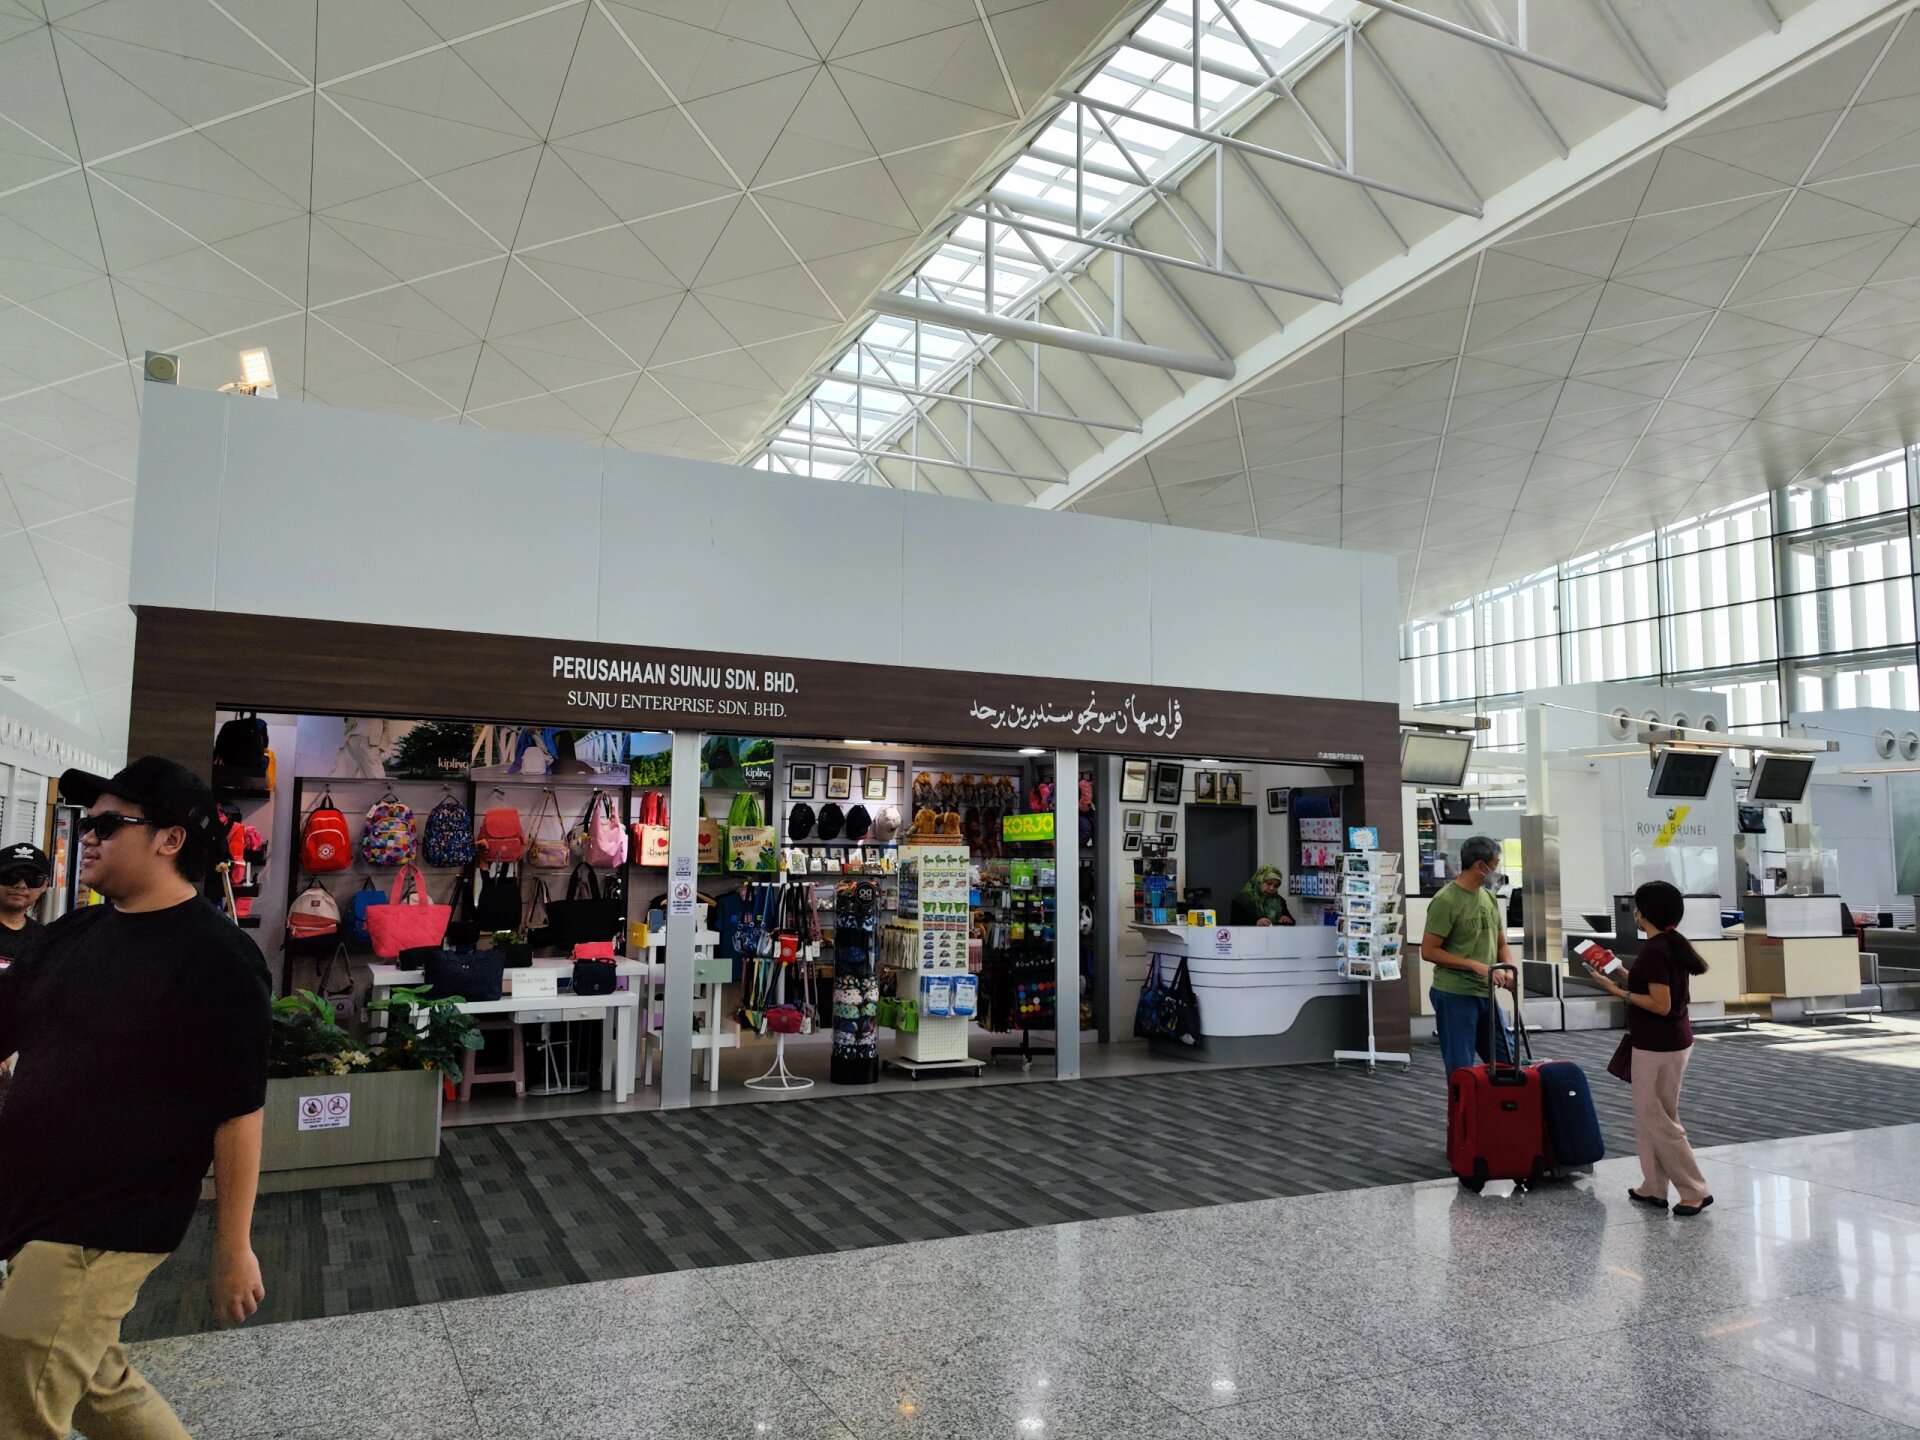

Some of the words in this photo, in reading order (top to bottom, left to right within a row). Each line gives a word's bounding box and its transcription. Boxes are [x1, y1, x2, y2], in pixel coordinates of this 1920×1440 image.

[552, 655, 666, 685] PERUSAHAAN
[669, 664, 721, 688] SUNJU
[725, 668, 760, 691] SDN.
[764, 671, 799, 694] BHD.
[567, 690, 618, 710] SUNJU
[621, 694, 715, 714] ENTERPRISE
[717, 699, 751, 715] SDN.
[754, 702, 787, 718] BHD.
[437, 756, 469, 771] kipling
[600, 761, 628, 776] kipling
[745, 766, 772, 780] kipling
[1003, 815, 1053, 834] KORJO
[1637, 821, 1668, 837] ROYAL
[1670, 822, 1706, 837] BRUNEI
